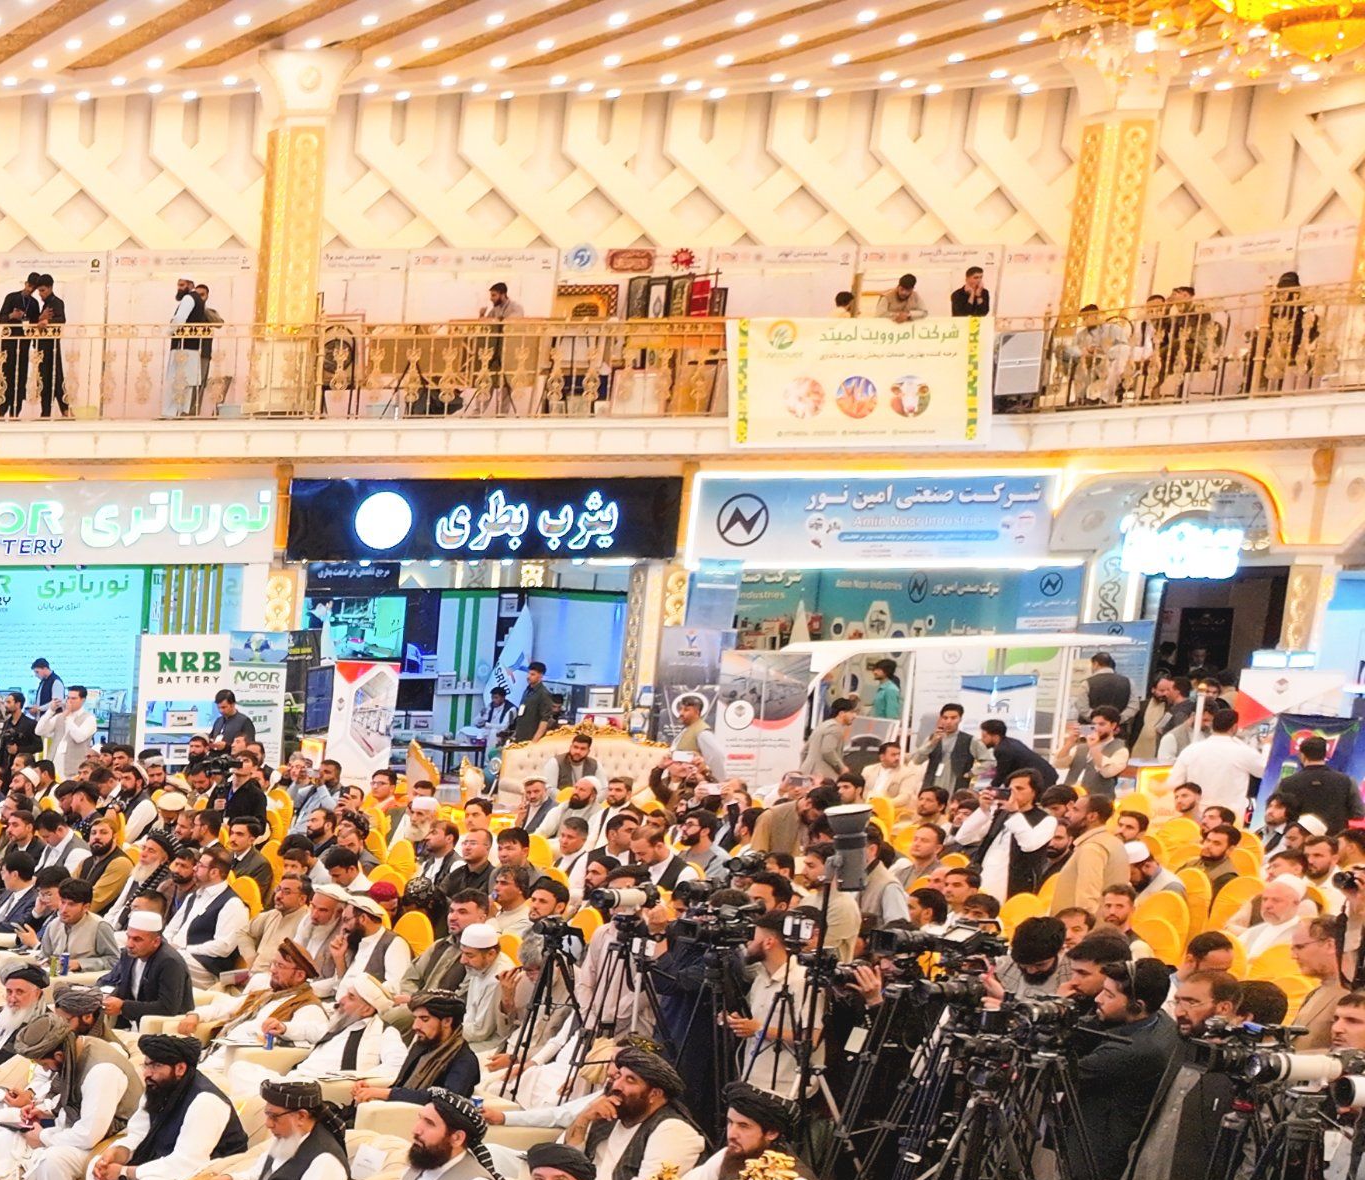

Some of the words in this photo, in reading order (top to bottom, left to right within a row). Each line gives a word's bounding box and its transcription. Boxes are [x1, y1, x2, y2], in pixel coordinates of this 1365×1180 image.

[157, 652, 221, 673] NRB
[157, 676, 220, 684] BATTERY
[234, 670, 281, 684] NOOR
